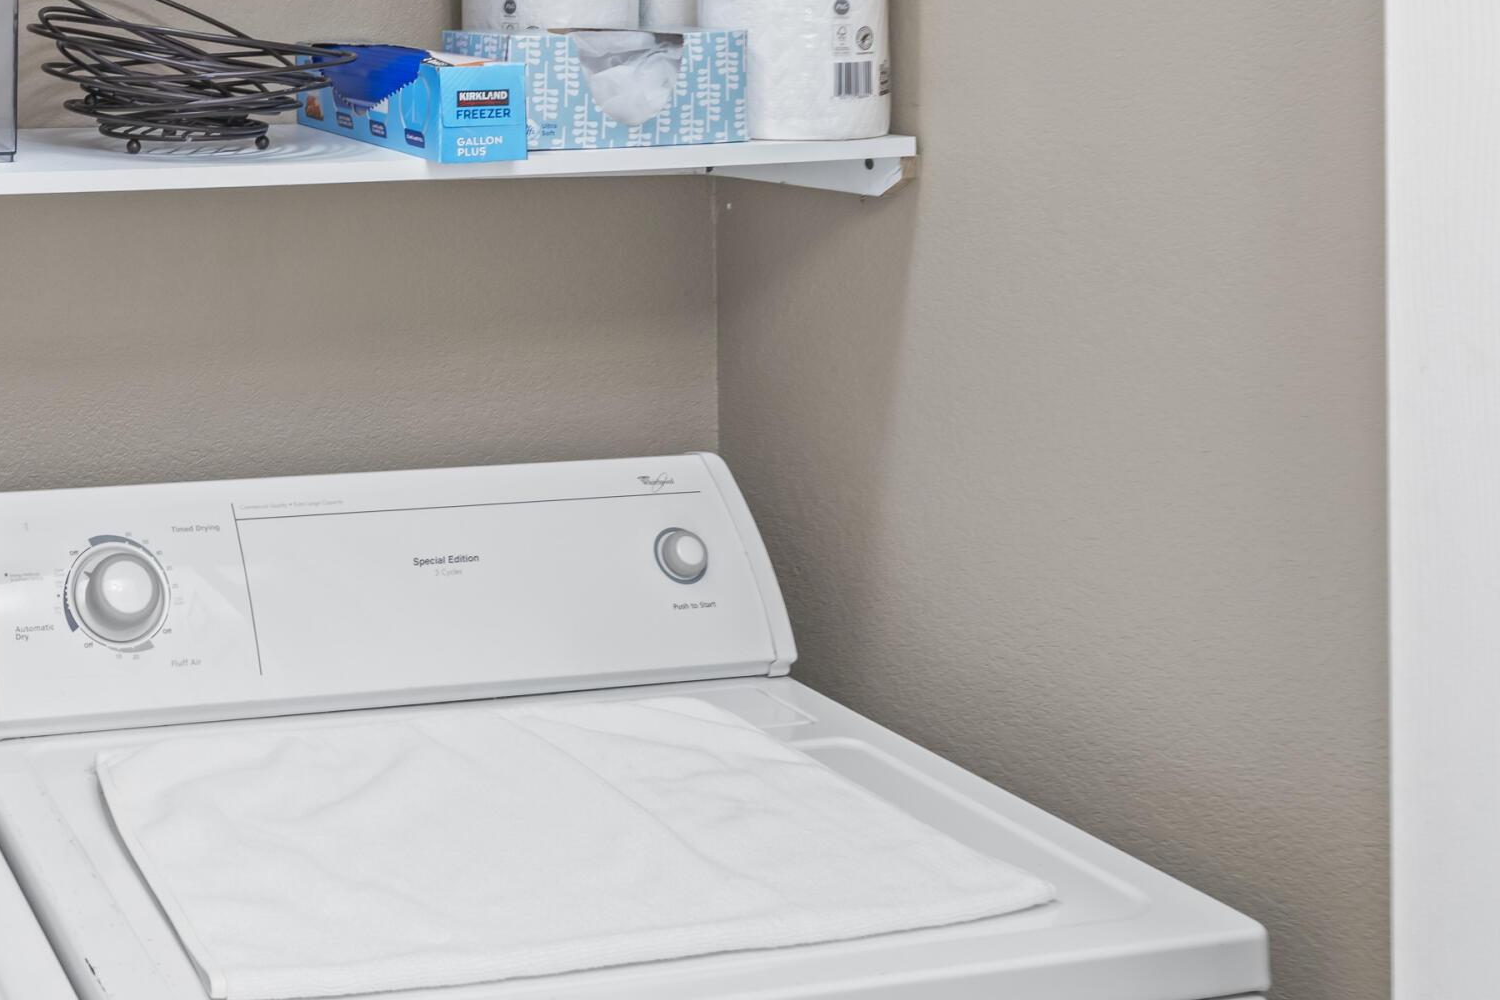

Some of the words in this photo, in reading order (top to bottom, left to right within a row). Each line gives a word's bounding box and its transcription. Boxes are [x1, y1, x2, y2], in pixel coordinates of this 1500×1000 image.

[459, 91, 508, 101] KIRKLAND
[456, 108, 511, 120] FREEZER
[457, 136, 503, 146] GALLON
[457, 147, 486, 157] PLUS
[171, 525, 194, 533] Timed
[195, 524, 221, 532] Drying
[413, 556, 446, 567] Special
[448, 554, 480, 564] Edition
[15, 624, 54, 633] Automatic
[15, 633, 29, 641] Dry
